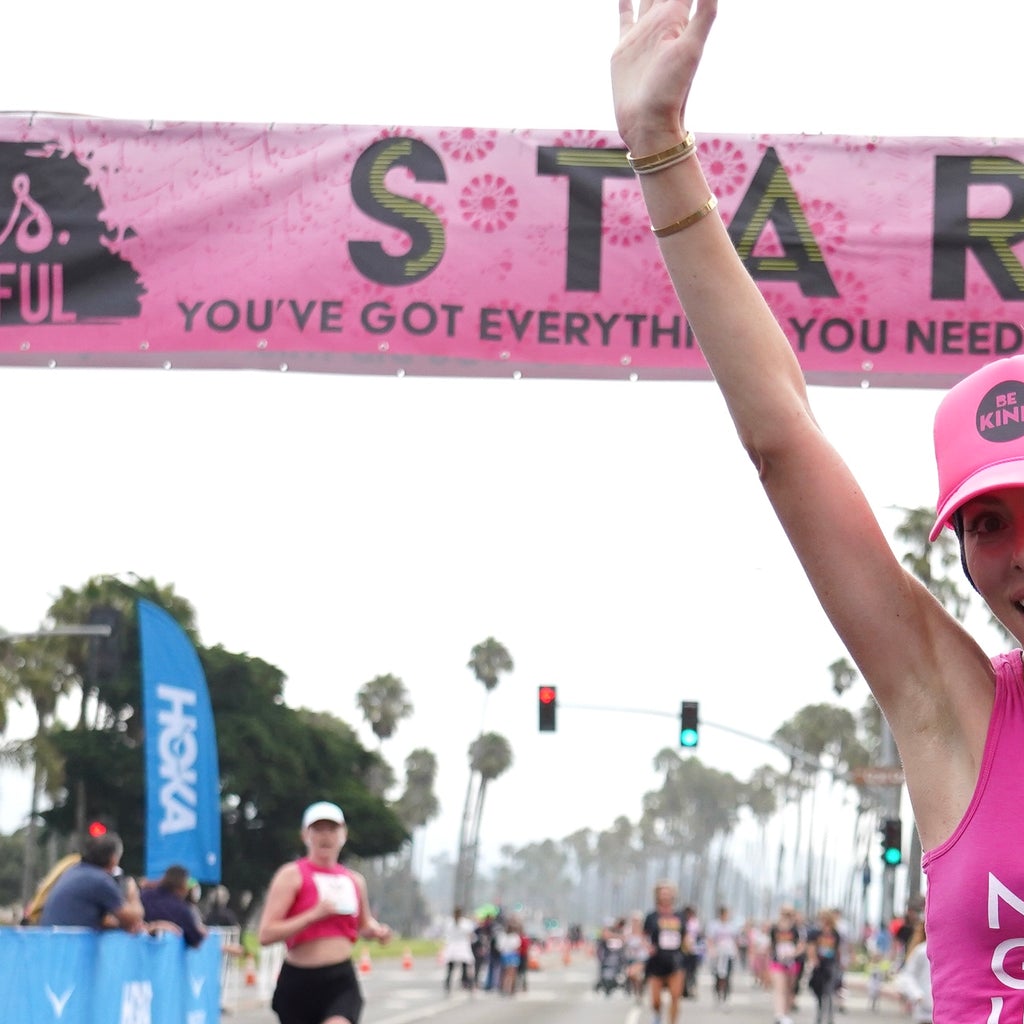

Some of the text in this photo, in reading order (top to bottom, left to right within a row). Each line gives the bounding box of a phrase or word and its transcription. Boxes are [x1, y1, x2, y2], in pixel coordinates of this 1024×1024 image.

[177, 298, 343, 333] YOU'VE
[361, 301, 463, 338] GOT
[479, 307, 695, 349] EVERYTHI
[789, 318, 888, 353] YOU
[906, 319, 1023, 355] NEED
[996, 392, 1016, 408] BE
[156, 683, 198, 837] HOKA
